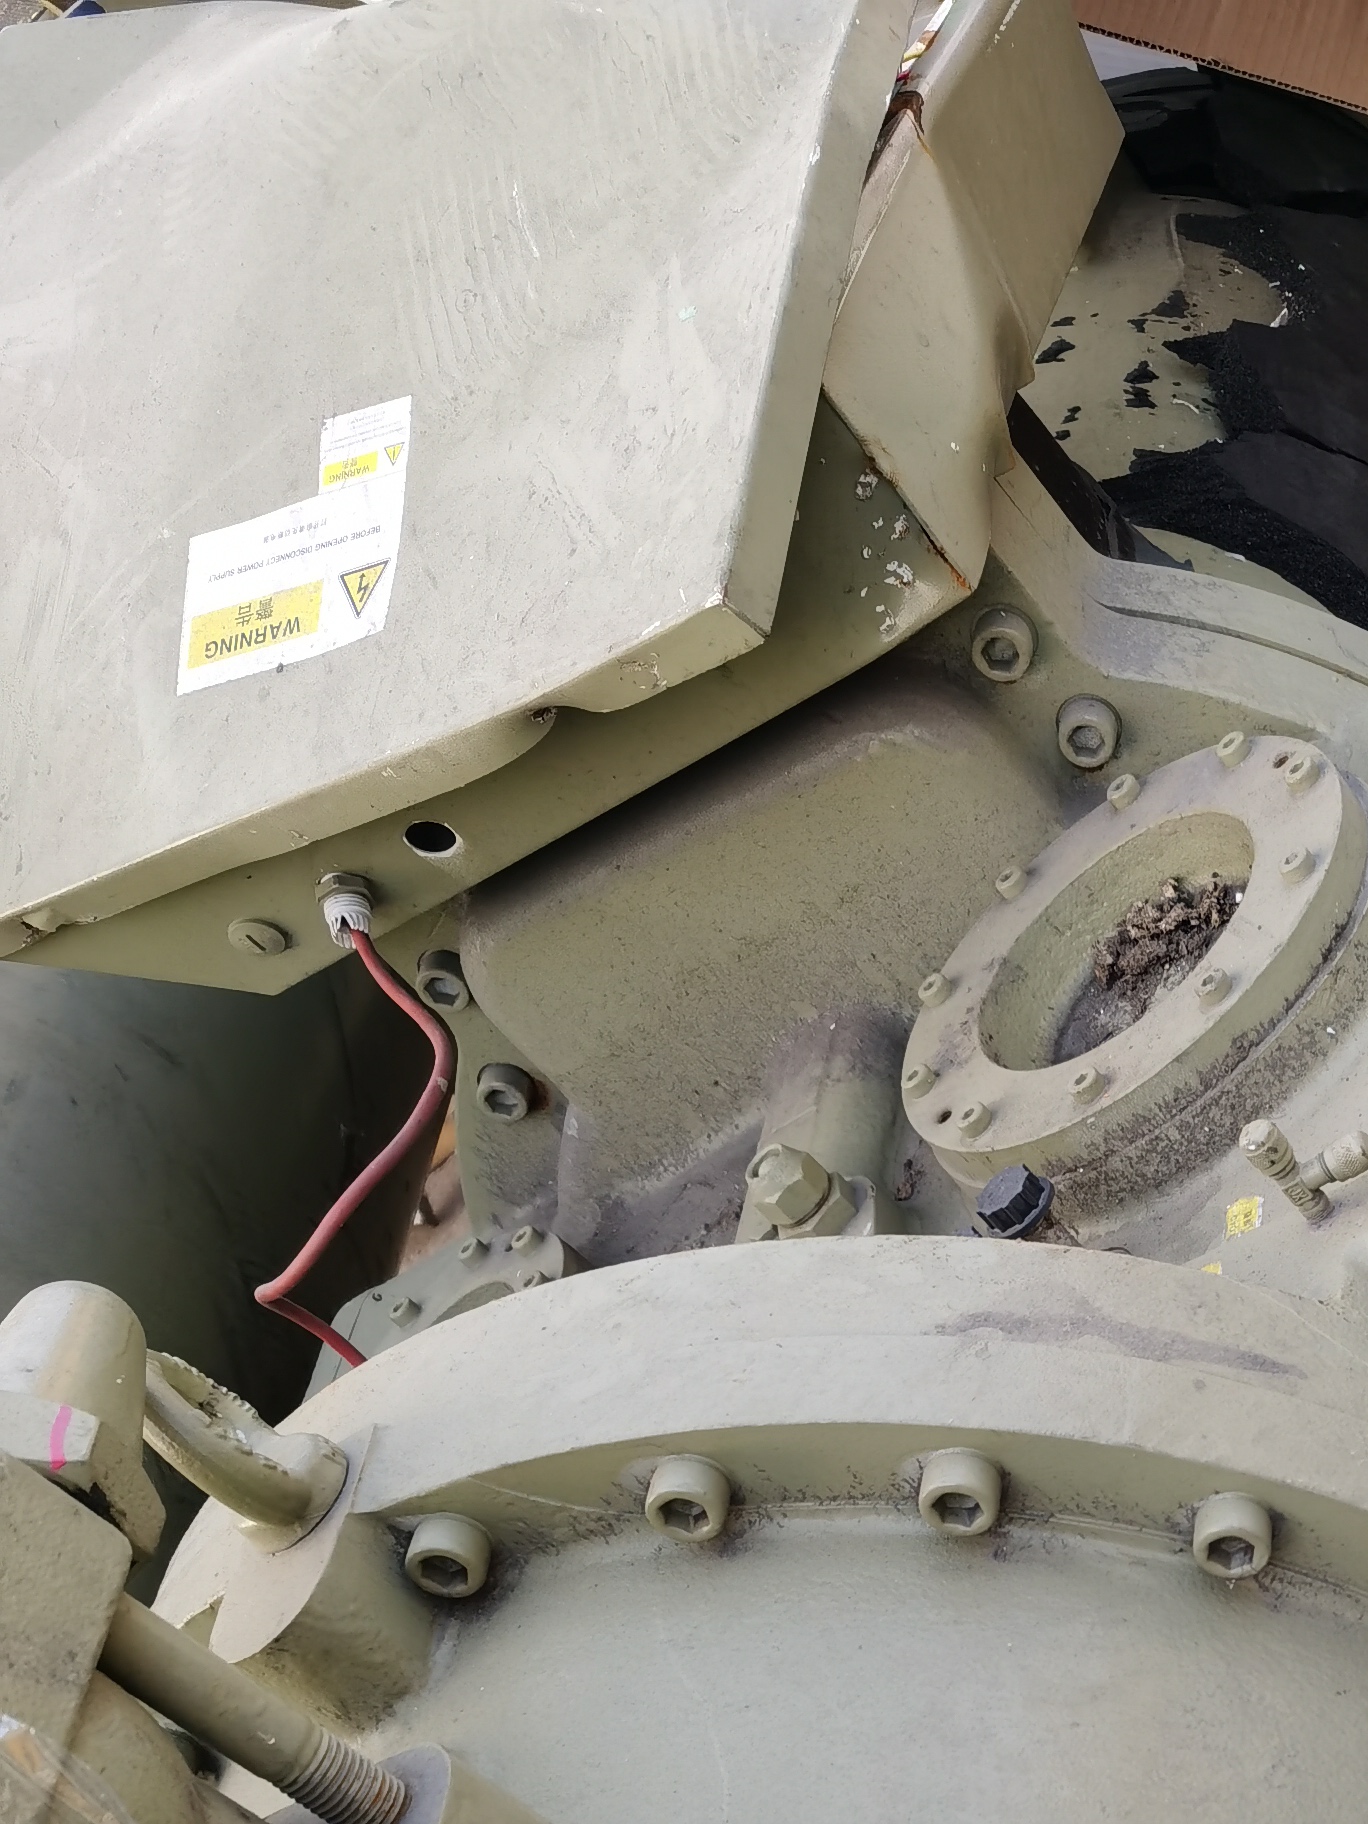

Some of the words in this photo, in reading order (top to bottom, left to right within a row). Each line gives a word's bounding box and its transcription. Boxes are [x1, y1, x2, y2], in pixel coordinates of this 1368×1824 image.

[328, 465, 370, 483] WARNING
[350, 525, 381, 541] BEFORE
[315, 536, 348, 552] OPENING
[237, 559, 264, 574] POWER
[208, 568, 235, 583] SUPPLY
[235, 597, 273, 627] 警告
[204, 617, 300, 659] WARNING
